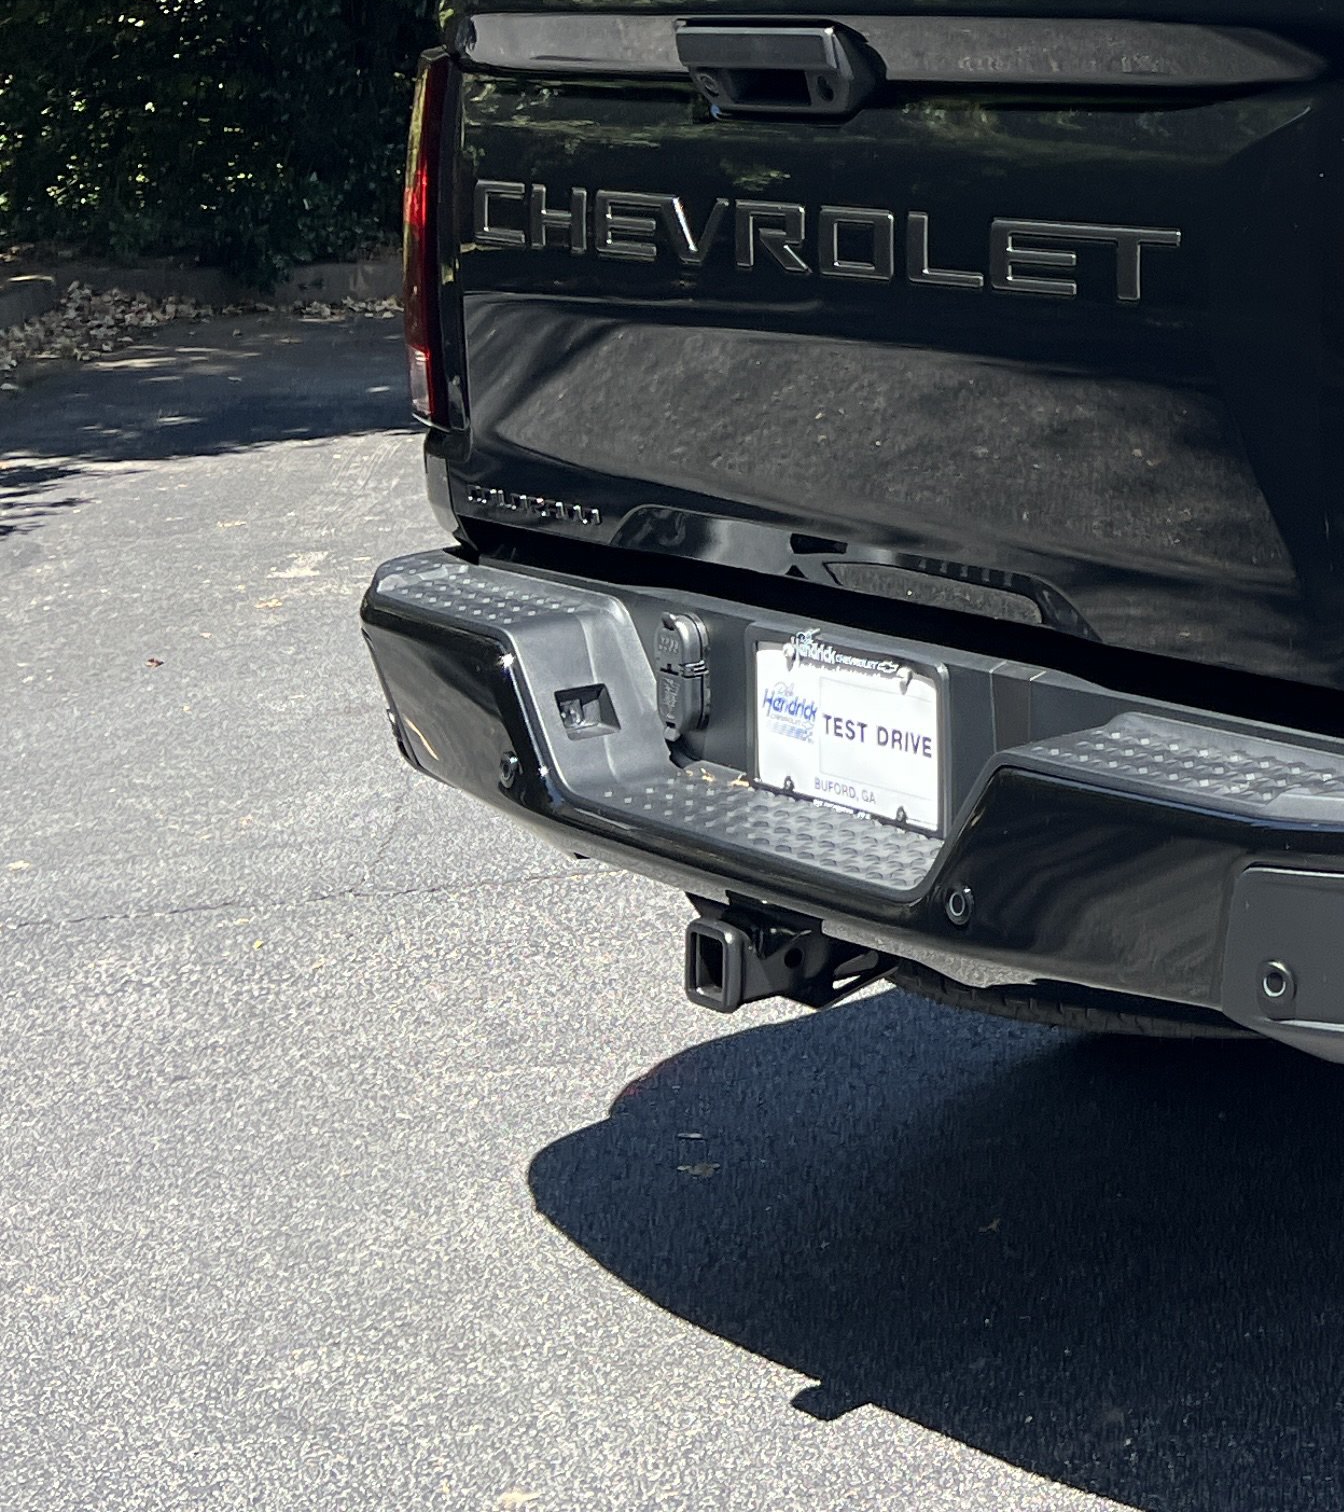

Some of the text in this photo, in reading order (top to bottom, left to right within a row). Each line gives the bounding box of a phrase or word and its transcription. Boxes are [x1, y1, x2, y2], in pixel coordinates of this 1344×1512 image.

[474, 178, 1181, 301] CHEVROLET
[762, 688, 818, 722] Hendrick
[823, 714, 932, 758] TEST DRIVE
[814, 777, 876, 804] BUFORD, GA
